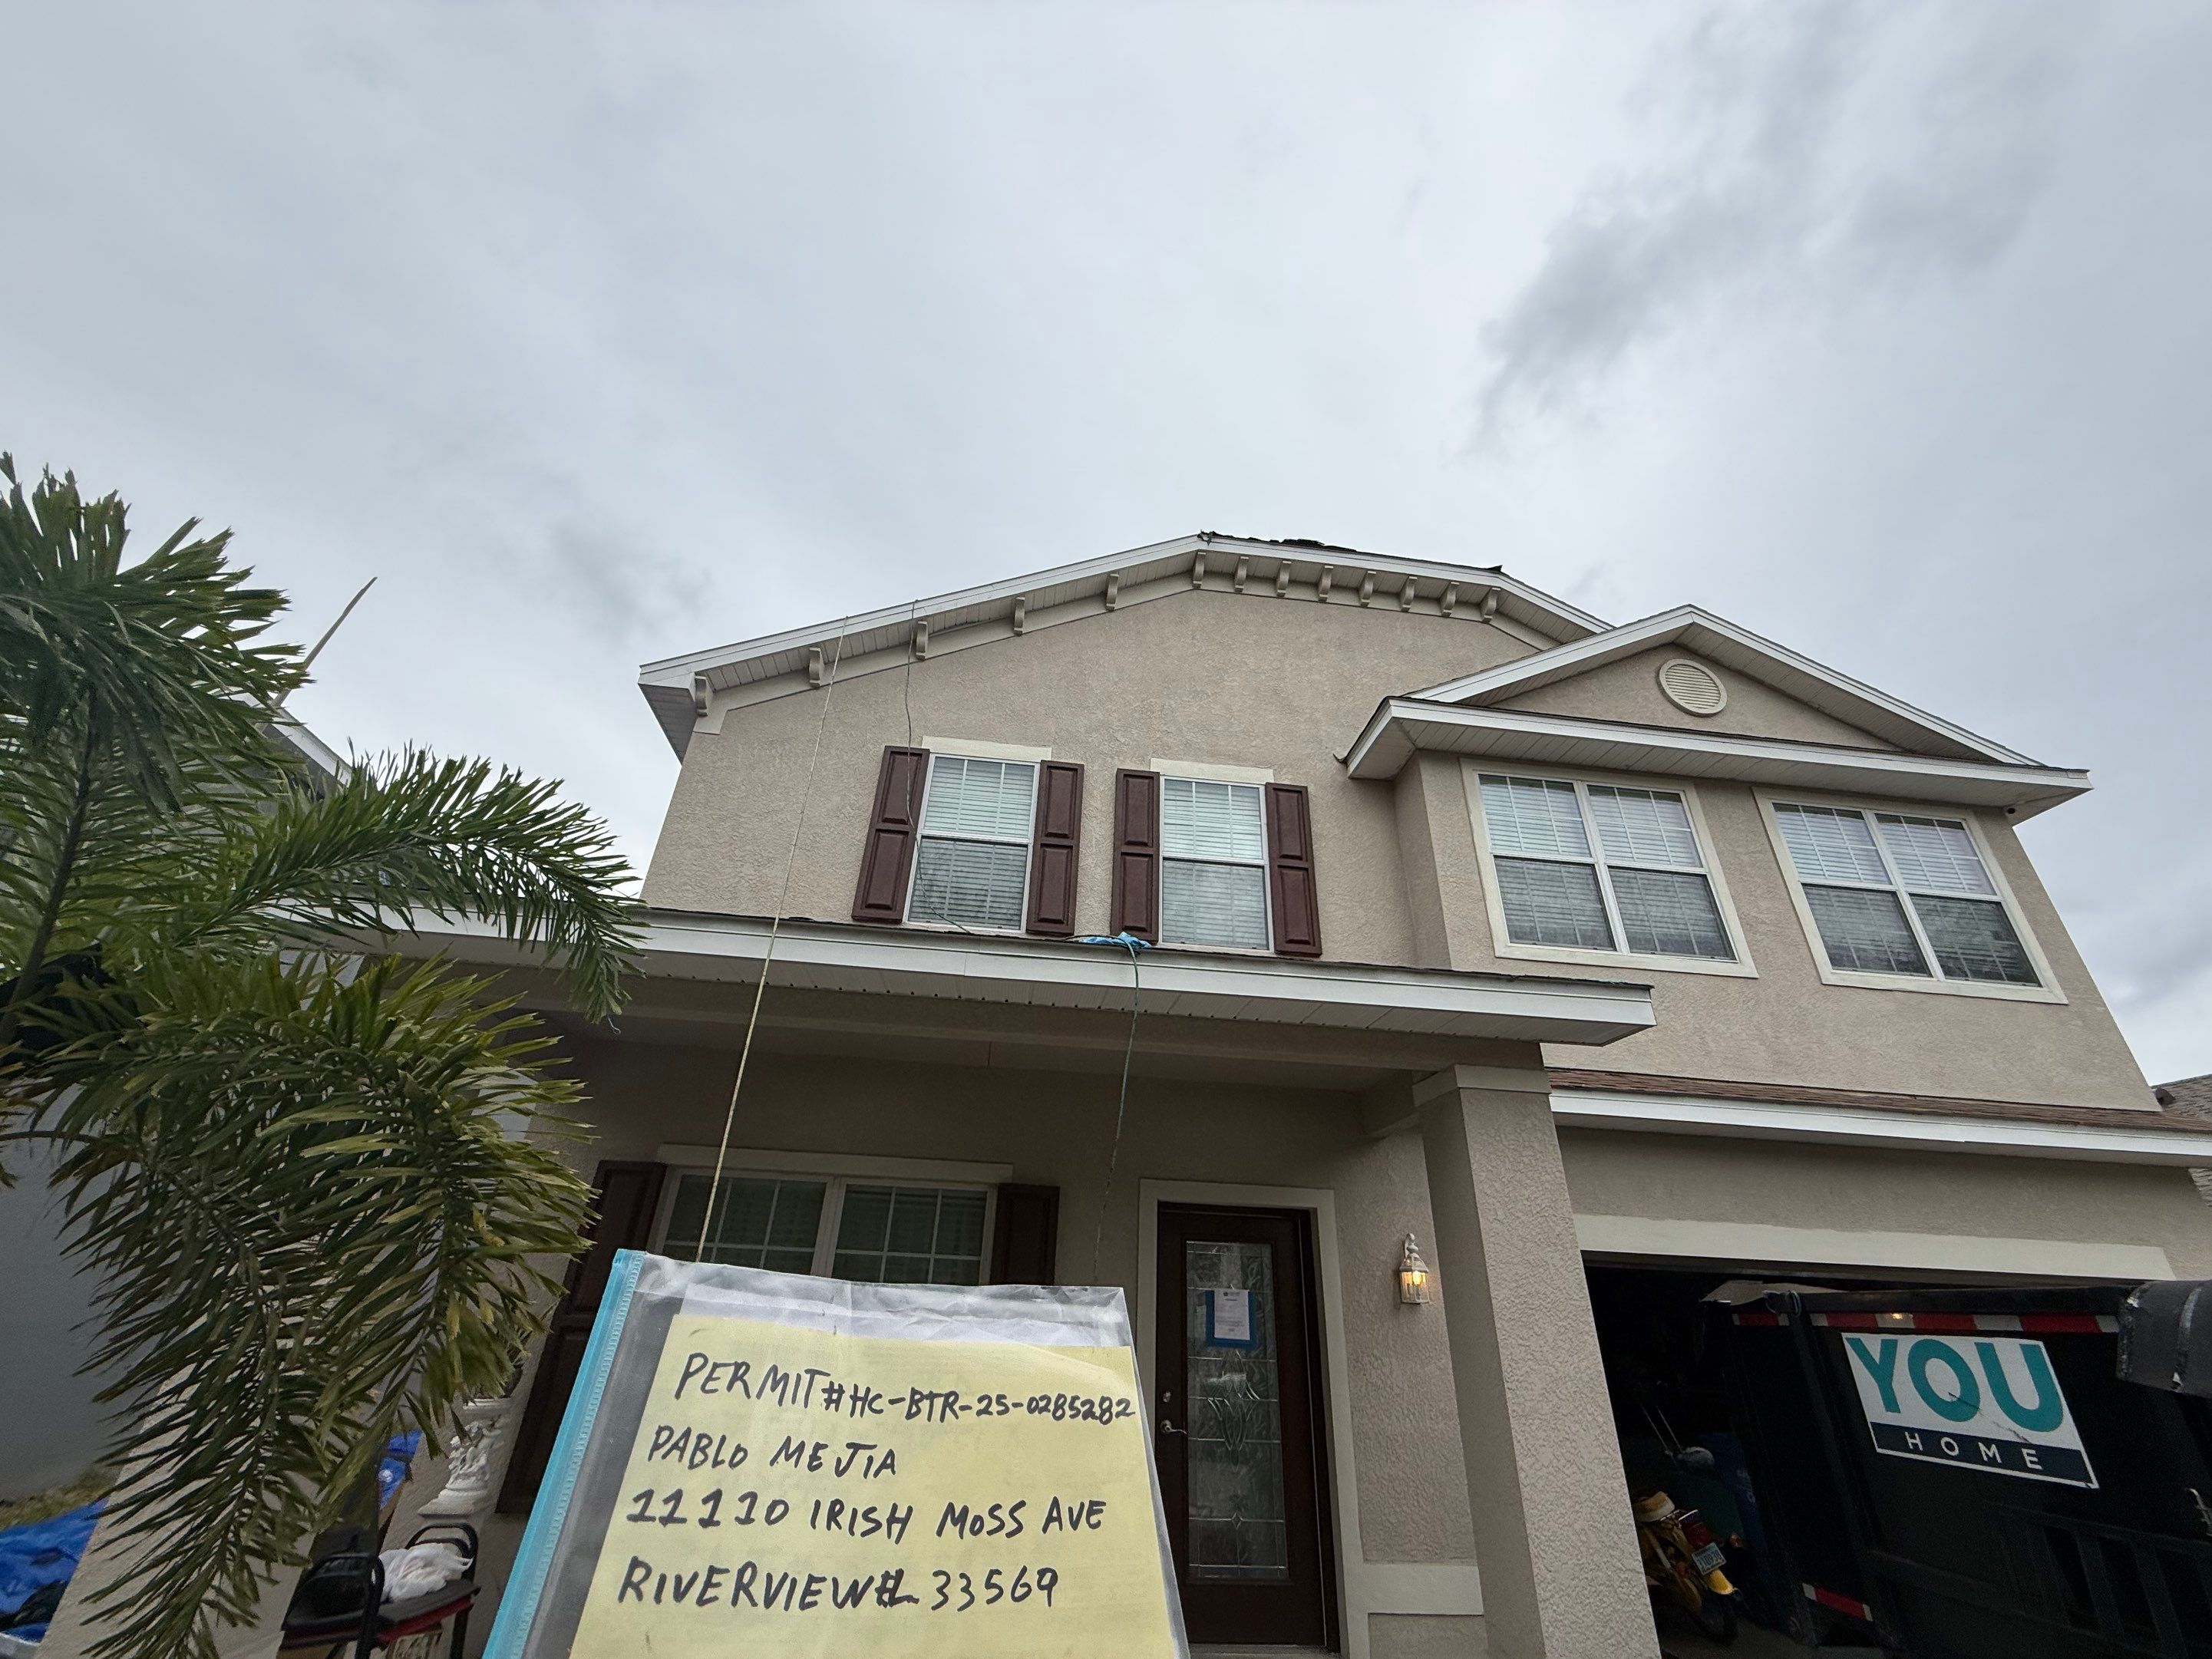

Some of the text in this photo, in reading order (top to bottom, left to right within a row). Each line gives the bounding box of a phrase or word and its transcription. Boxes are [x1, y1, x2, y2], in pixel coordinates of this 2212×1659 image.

[1845, 1337, 2064, 1433] YOU
[648, 1425, 896, 1479] PABLO MEJIA
[1904, 1431, 2043, 1470] HOME
[626, 1488, 1107, 1545] 11110 IRISH MOSS AVE
[618, 1555, 875, 1611] RIVERVIEW
[931, 1565, 1058, 1612] 33569
